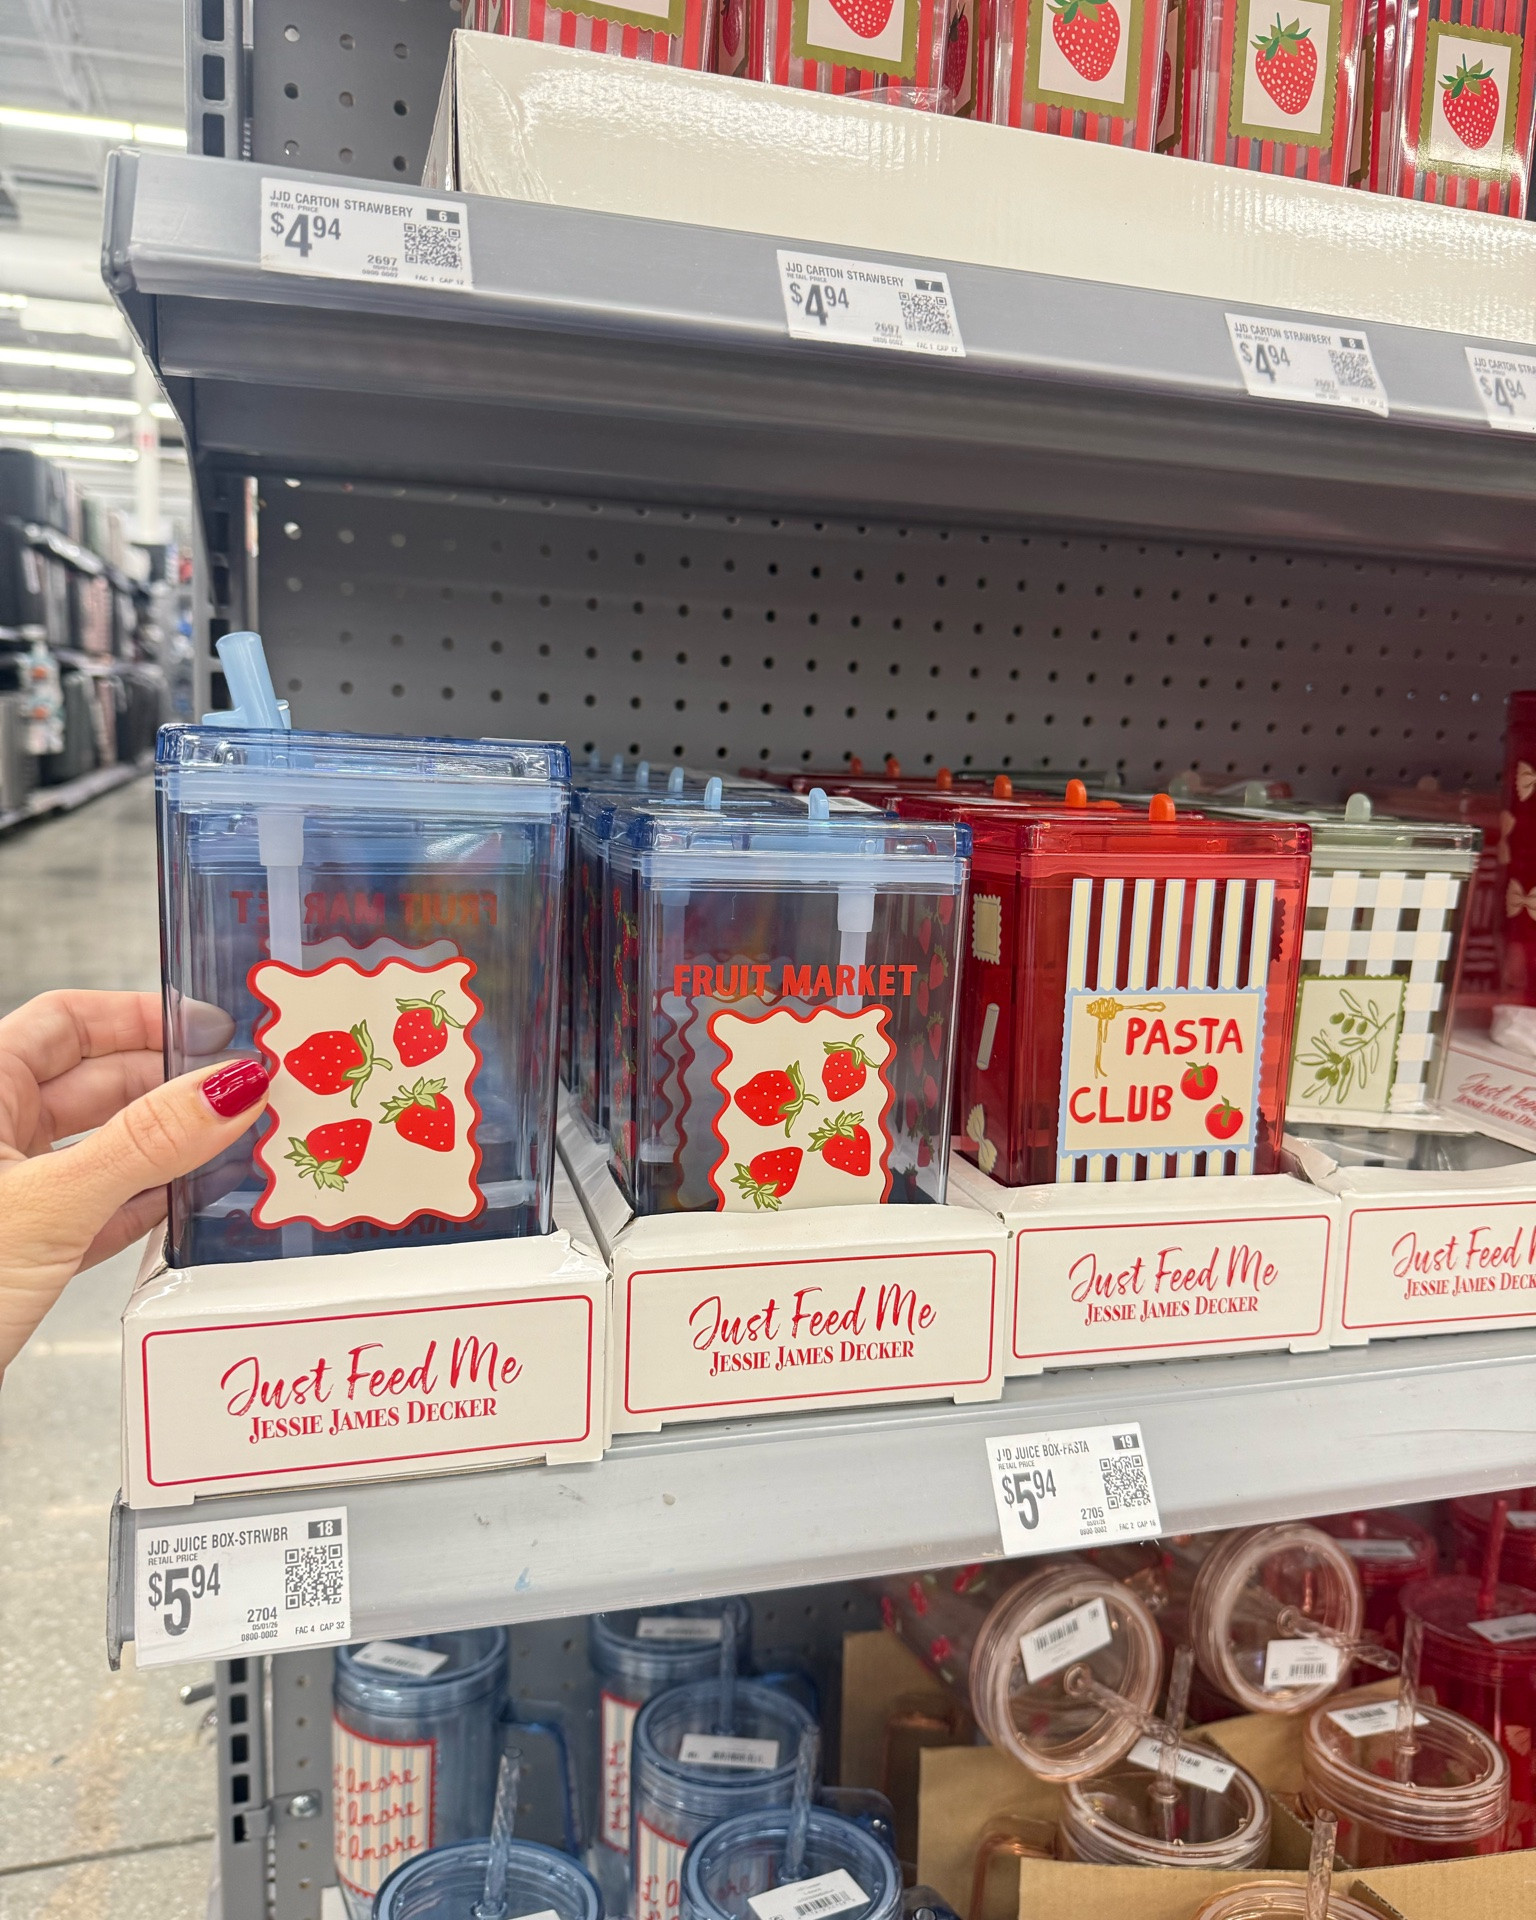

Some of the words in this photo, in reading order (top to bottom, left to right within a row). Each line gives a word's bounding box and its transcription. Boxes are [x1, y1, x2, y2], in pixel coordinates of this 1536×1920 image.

[270, 190, 290, 202] JJD
[296, 192, 340, 208] CARTON
[344, 200, 413, 218] STRAWBERY
[438, 212, 448, 222] 6
[367, 254, 398, 266] 2697
[786, 262, 802, 273] JJD
[806, 264, 844, 279] CARTON
[847, 270, 904, 287] STRAWBERY
[925, 281, 932, 290] 7
[1234, 322, 1248, 333] JJD
[1250, 324, 1282, 338] CARTON
[1284, 330, 1332, 345] STRAWBERY
[1488, 359, 1517, 372] CARTON
[673, 964, 772, 997] FRUIT
[782, 964, 918, 996] MARKET
[1125, 1017, 1243, 1056] PASTA
[1069, 1084, 1174, 1124] CLUB
[1392, 1232, 1459, 1278] Just
[1466, 1226, 1523, 1269] Feed
[1068, 1253, 1146, 1302] Just
[1154, 1246, 1220, 1294] Feed
[1226, 1244, 1279, 1292] Me
[1404, 1278, 1450, 1300] JESSIE
[1452, 1275, 1496, 1296] JAMES
[688, 1295, 782, 1351] Just
[792, 1285, 866, 1339] Feed
[875, 1283, 937, 1335] Me
[1084, 1302, 1136, 1326] JESSIE
[1140, 1299, 1190, 1322] JAMES
[1194, 1295, 1258, 1316] DECKER
[709, 1351, 771, 1377] JESSIE
[775, 1345, 834, 1370] JAMES
[840, 1340, 914, 1363] DECKER
[220, 1356, 334, 1417] Just
[346, 1340, 438, 1401] Feed
[451, 1335, 523, 1392] Me
[249, 1414, 324, 1444] JESSIE
[328, 1406, 400, 1436] JAMES
[406, 1398, 498, 1426] DECKER
[1015, 1445, 1040, 1460] JUICE
[1120, 1436, 1133, 1448] 19
[1018, 1460, 1035, 1468] PRICE
[1080, 1507, 1104, 1520] 2705
[316, 1521, 334, 1536] 18
[148, 1539, 169, 1556] JJD
[173, 1535, 208, 1553] JUICE
[212, 1527, 288, 1549] BOX-STRWBR
[148, 1556, 174, 1566] RETAIL
[176, 1553, 198, 1563] PRICE
[247, 1607, 278, 1623] 2704
[252, 1622, 278, 1631] 05/01/26
[295, 1626, 308, 1635] FAC
[310, 1625, 315, 1634] 4
[320, 1623, 335, 1632] CAP
[336, 1621, 345, 1630] 32
